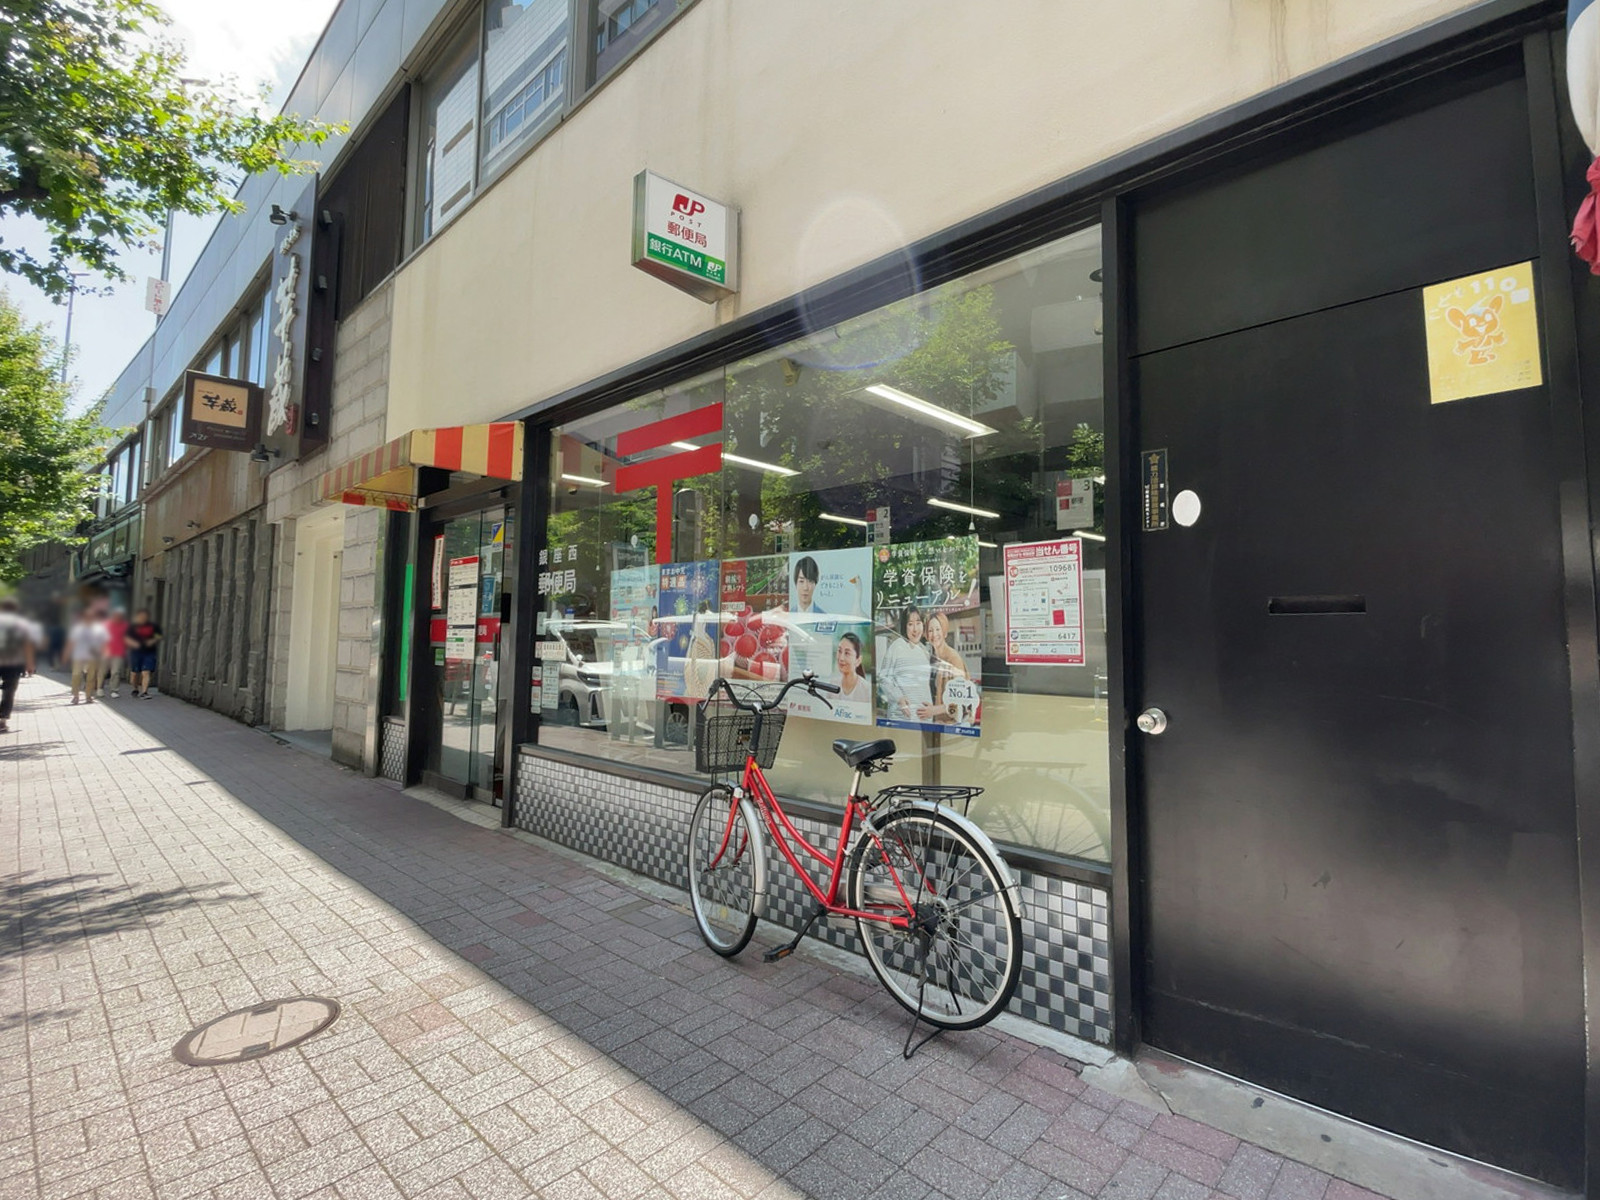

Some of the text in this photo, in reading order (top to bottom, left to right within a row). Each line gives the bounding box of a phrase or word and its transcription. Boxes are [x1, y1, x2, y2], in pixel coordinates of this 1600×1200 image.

[670, 211, 702, 228] POST
[667, 220, 707, 248] 郵便局
[649, 238, 702, 268] 銀行ATM
[1083, 479, 1090, 491] 3
[883, 508, 889, 518] 2
[538, 544, 578, 566] 銀座西
[1035, 543, 1078, 557] 当せん番号
[1049, 563, 1076, 572] 109681
[538, 569, 577, 596] 郵便局
[948, 686, 974, 699] No.1
[834, 708, 853, 719] Aflac
